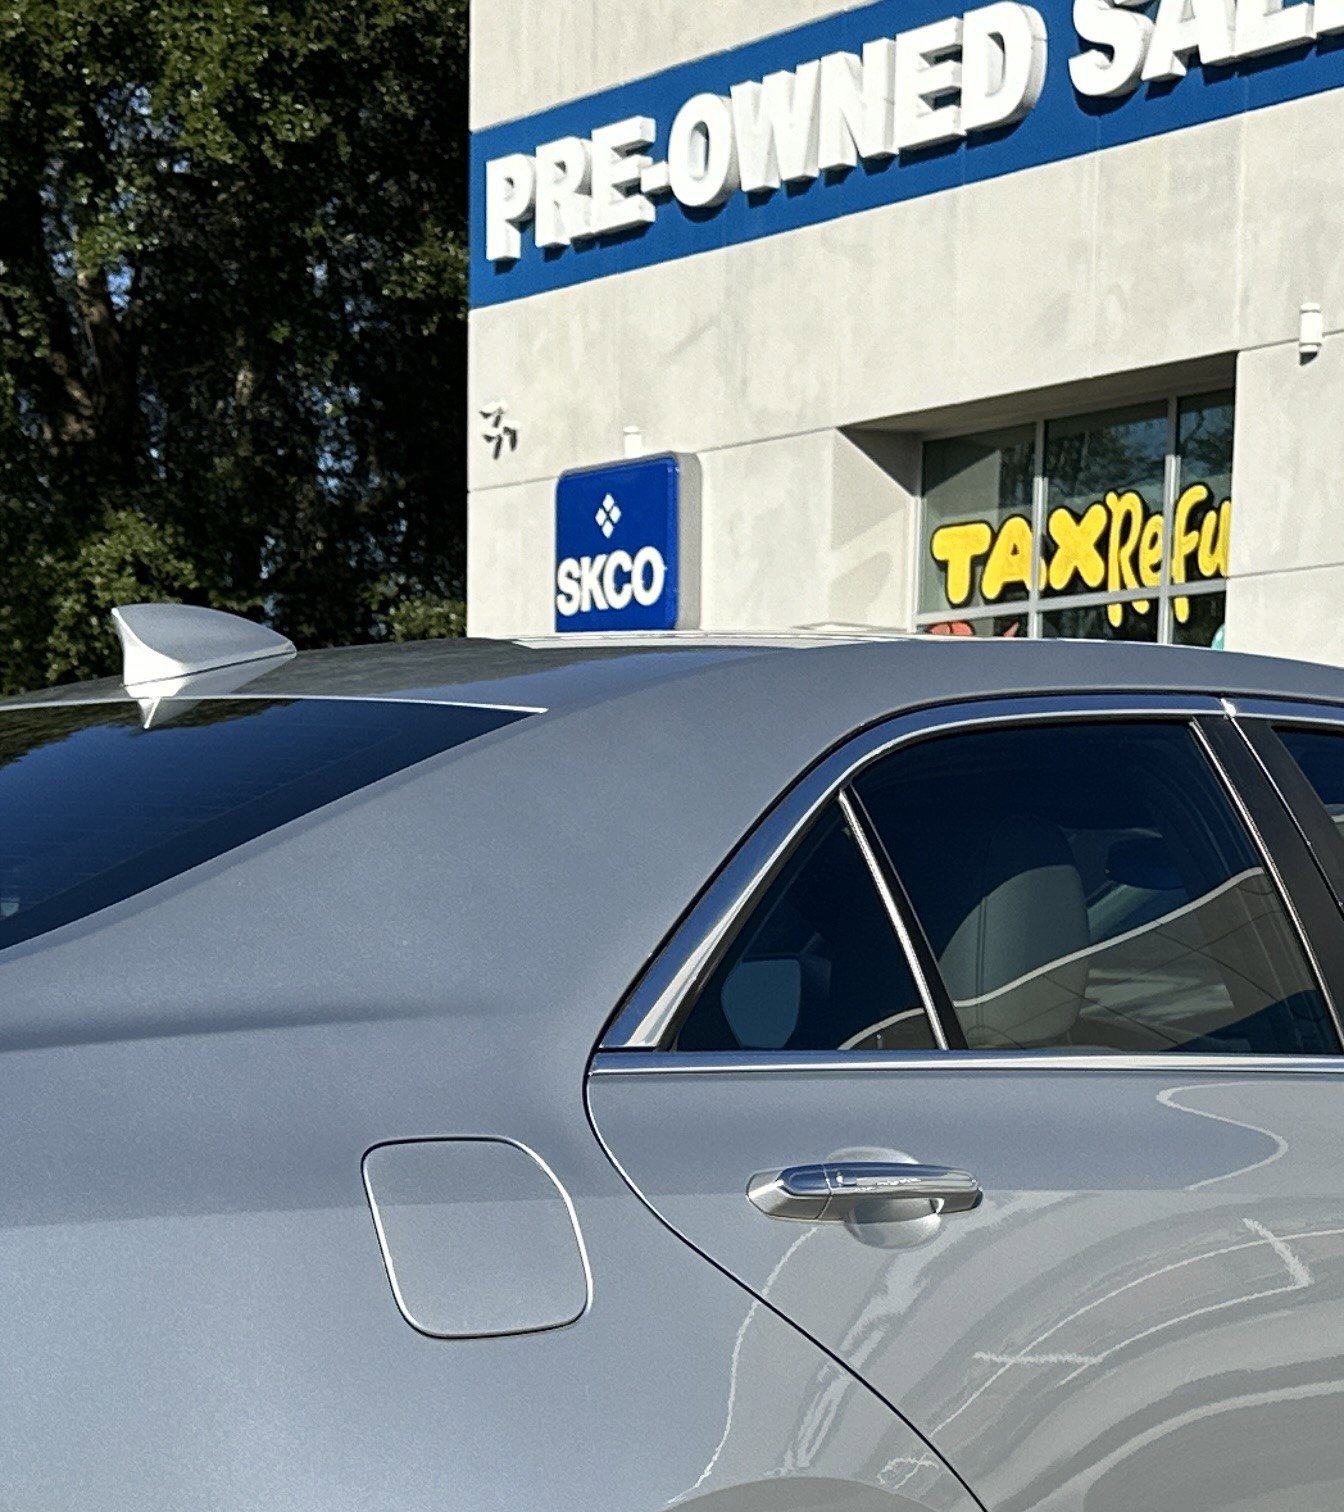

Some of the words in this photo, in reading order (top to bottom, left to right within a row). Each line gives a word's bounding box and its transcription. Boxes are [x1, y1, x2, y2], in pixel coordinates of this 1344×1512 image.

[485, 1, 1047, 262] PRE-OWNED
[556, 545, 667, 617] SKCO
[931, 502, 1108, 605] TAX
